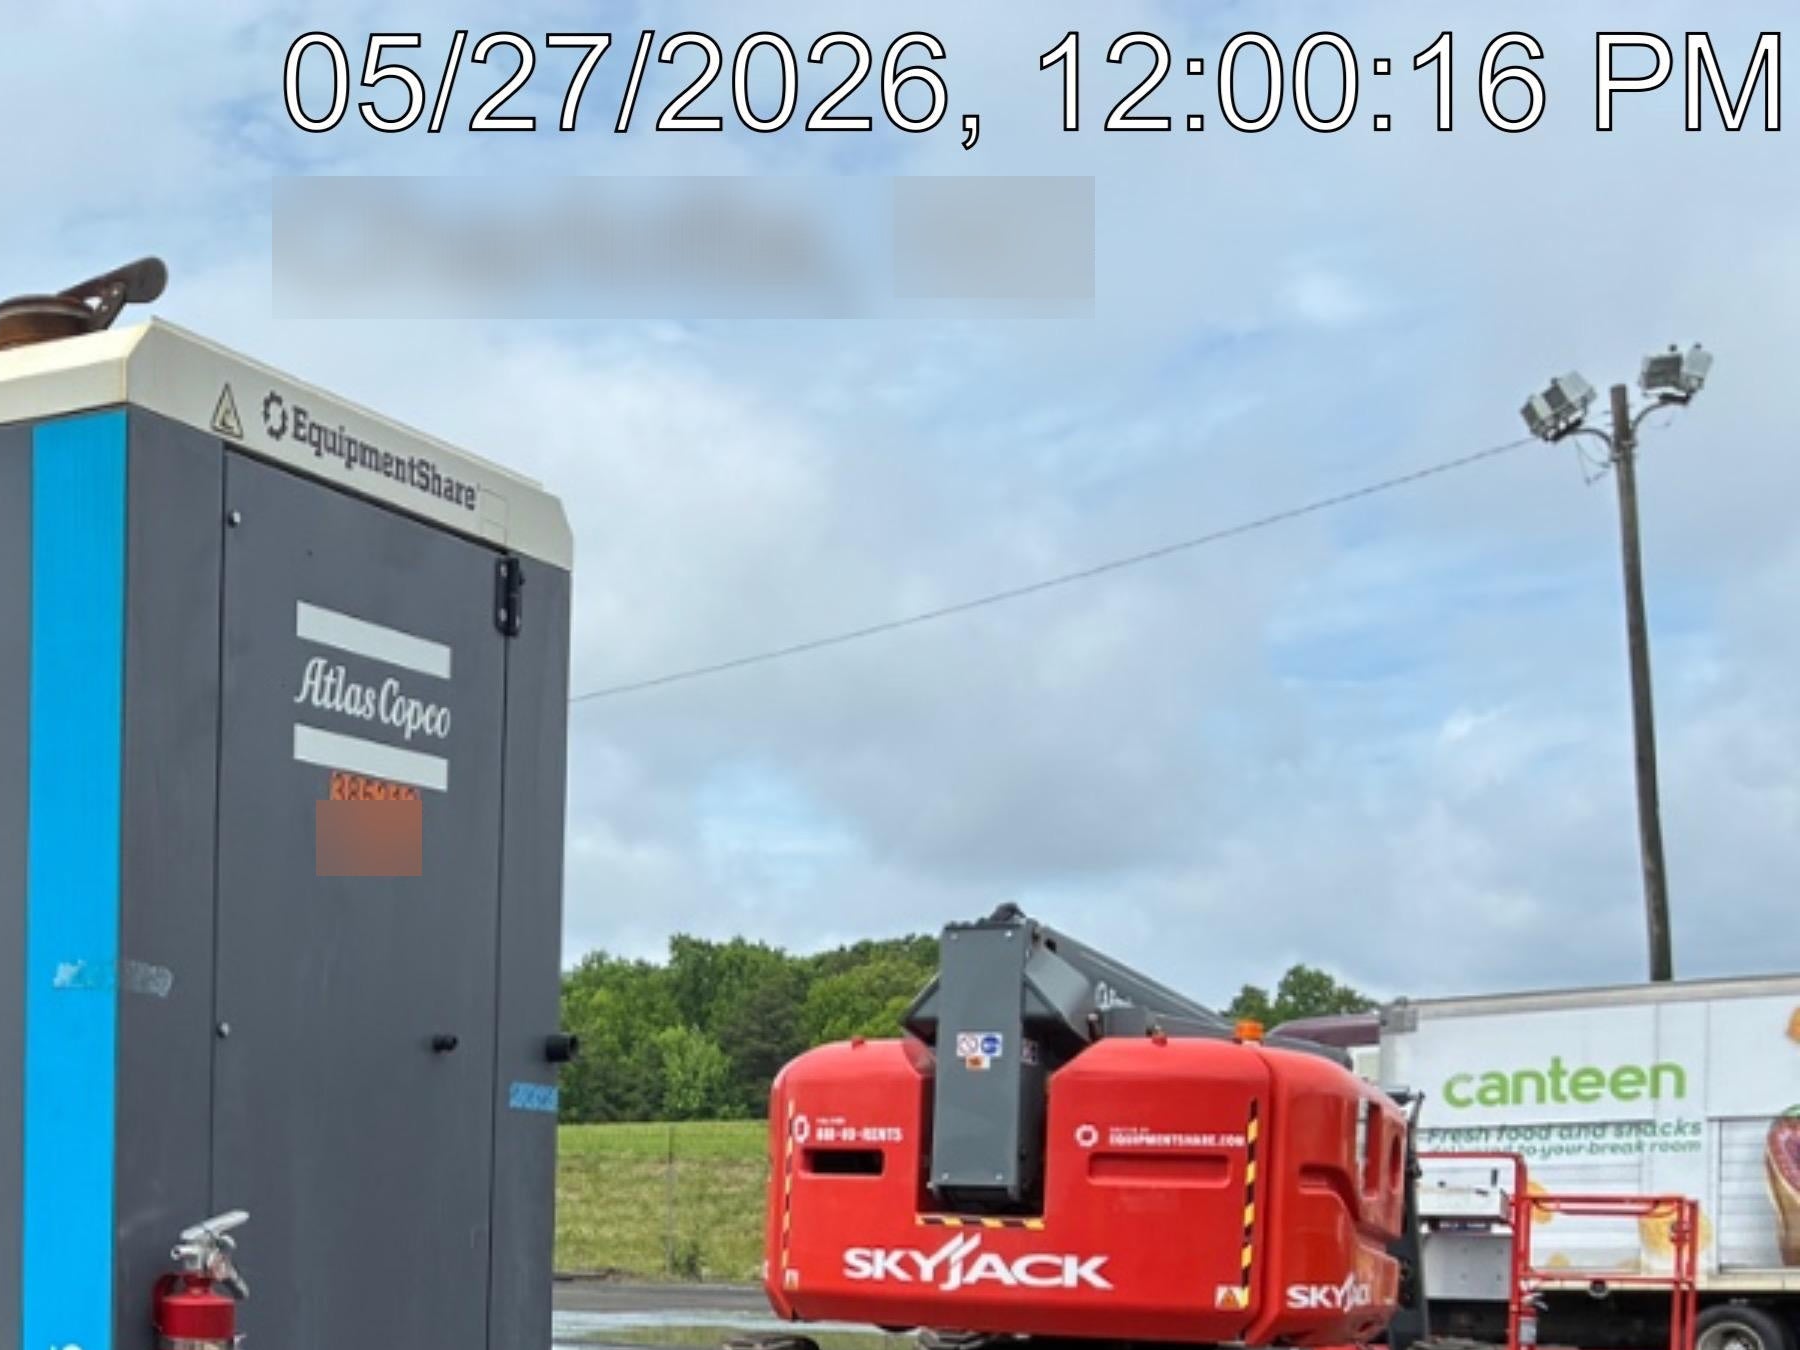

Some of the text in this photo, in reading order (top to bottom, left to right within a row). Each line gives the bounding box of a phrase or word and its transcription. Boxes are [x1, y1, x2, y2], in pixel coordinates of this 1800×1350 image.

[291, 405, 476, 511] EquipmentShare
[293, 655, 451, 740] Atlas Copco
[1442, 1055, 1686, 1108] canteen
[843, 1233, 1113, 1291] SKYJACK
